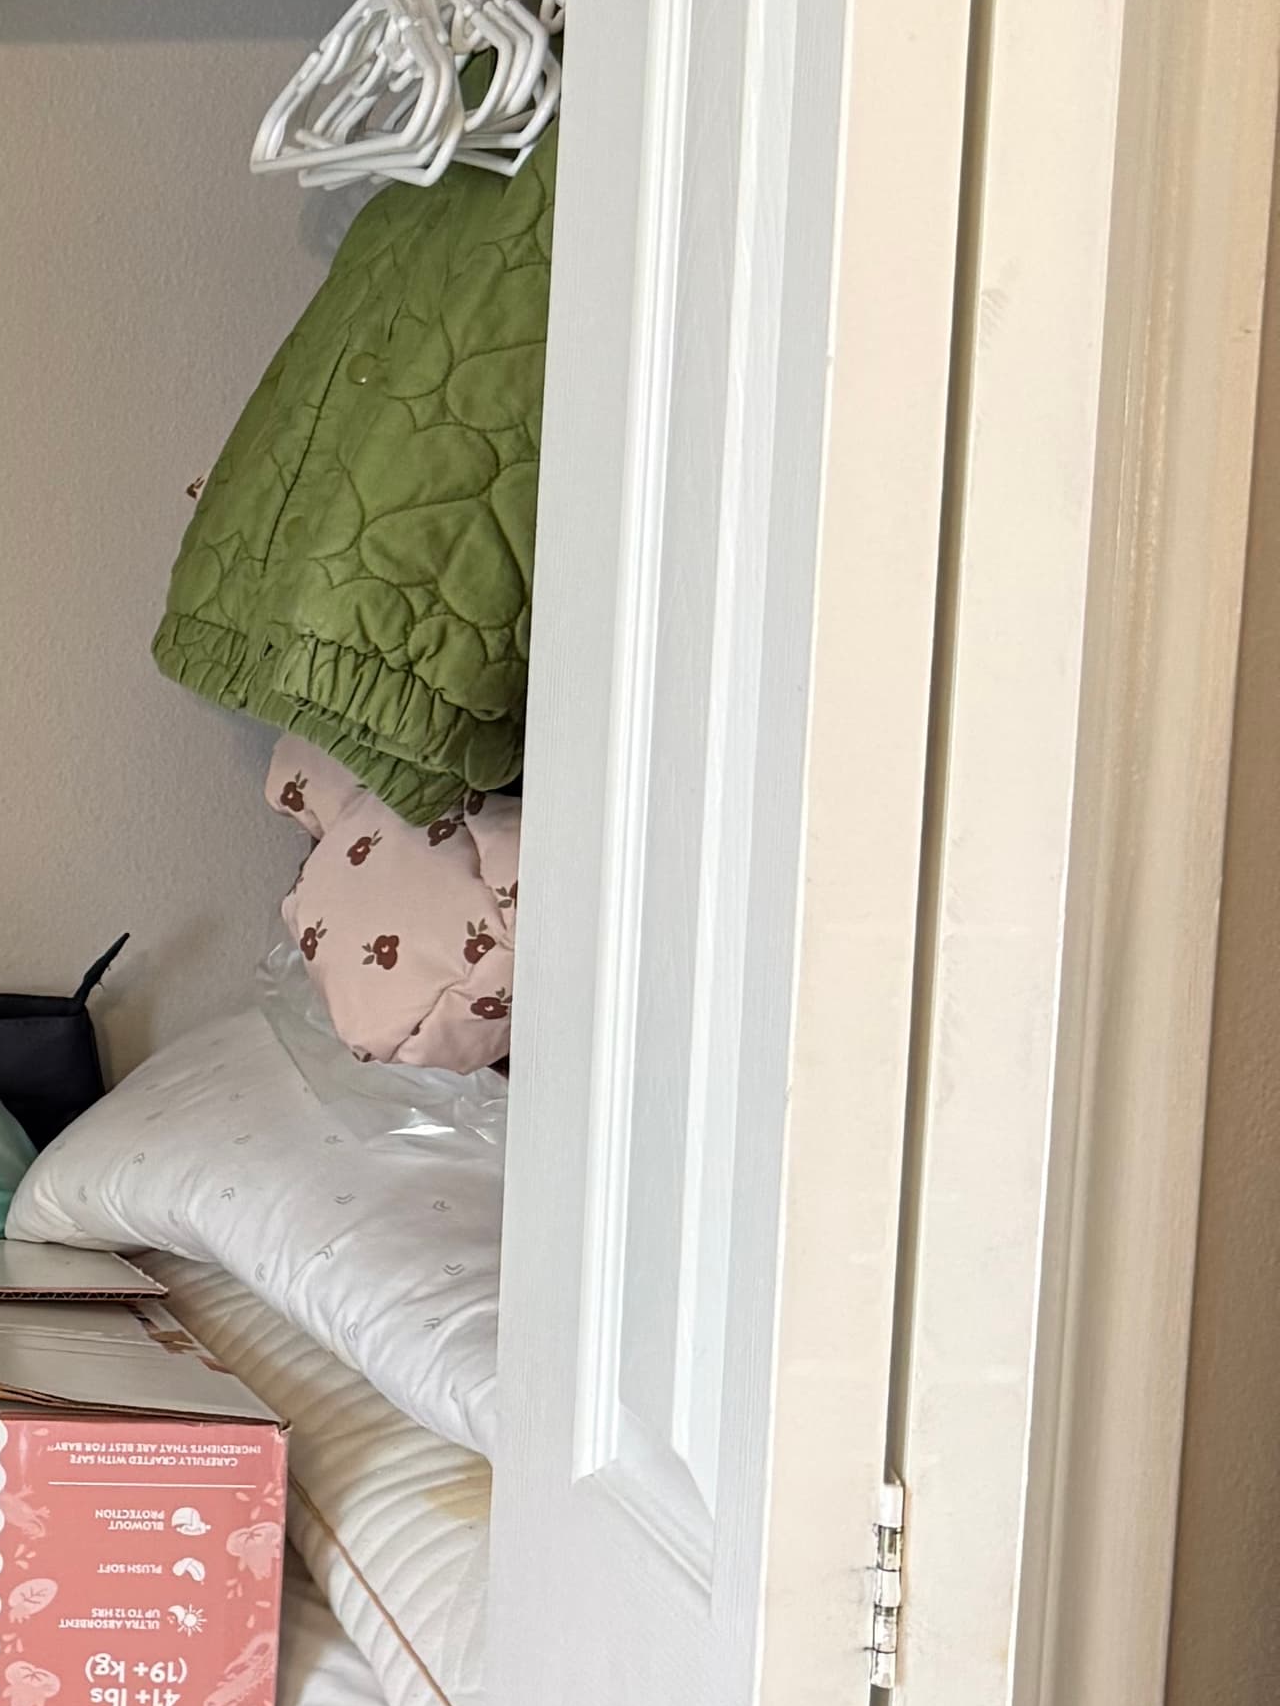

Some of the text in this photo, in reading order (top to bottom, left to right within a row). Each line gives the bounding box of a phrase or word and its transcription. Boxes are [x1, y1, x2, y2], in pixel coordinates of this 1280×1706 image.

[84, 1442, 107, 1453] FOR
[108, 1442, 135, 1453] BEST
[135, 1443, 158, 1453] ARE
[159, 1443, 189, 1454] THAT
[191, 1443, 262, 1456] INGREDIENTS
[69, 1453, 238, 1467] CAREFULLY CRAFTED WITH SAFE
[95, 1508, 165, 1520] PROTECTION
[108, 1519, 164, 1531] BLOWOUT
[97, 1562, 163, 1574] PLUSH SOFT
[91, 1607, 161, 1618] UP TO 12 HRS
[58, 1617, 161, 1629] ULTRA ABSORBENT
[84, 1652, 187, 1684] (19+ kg)
